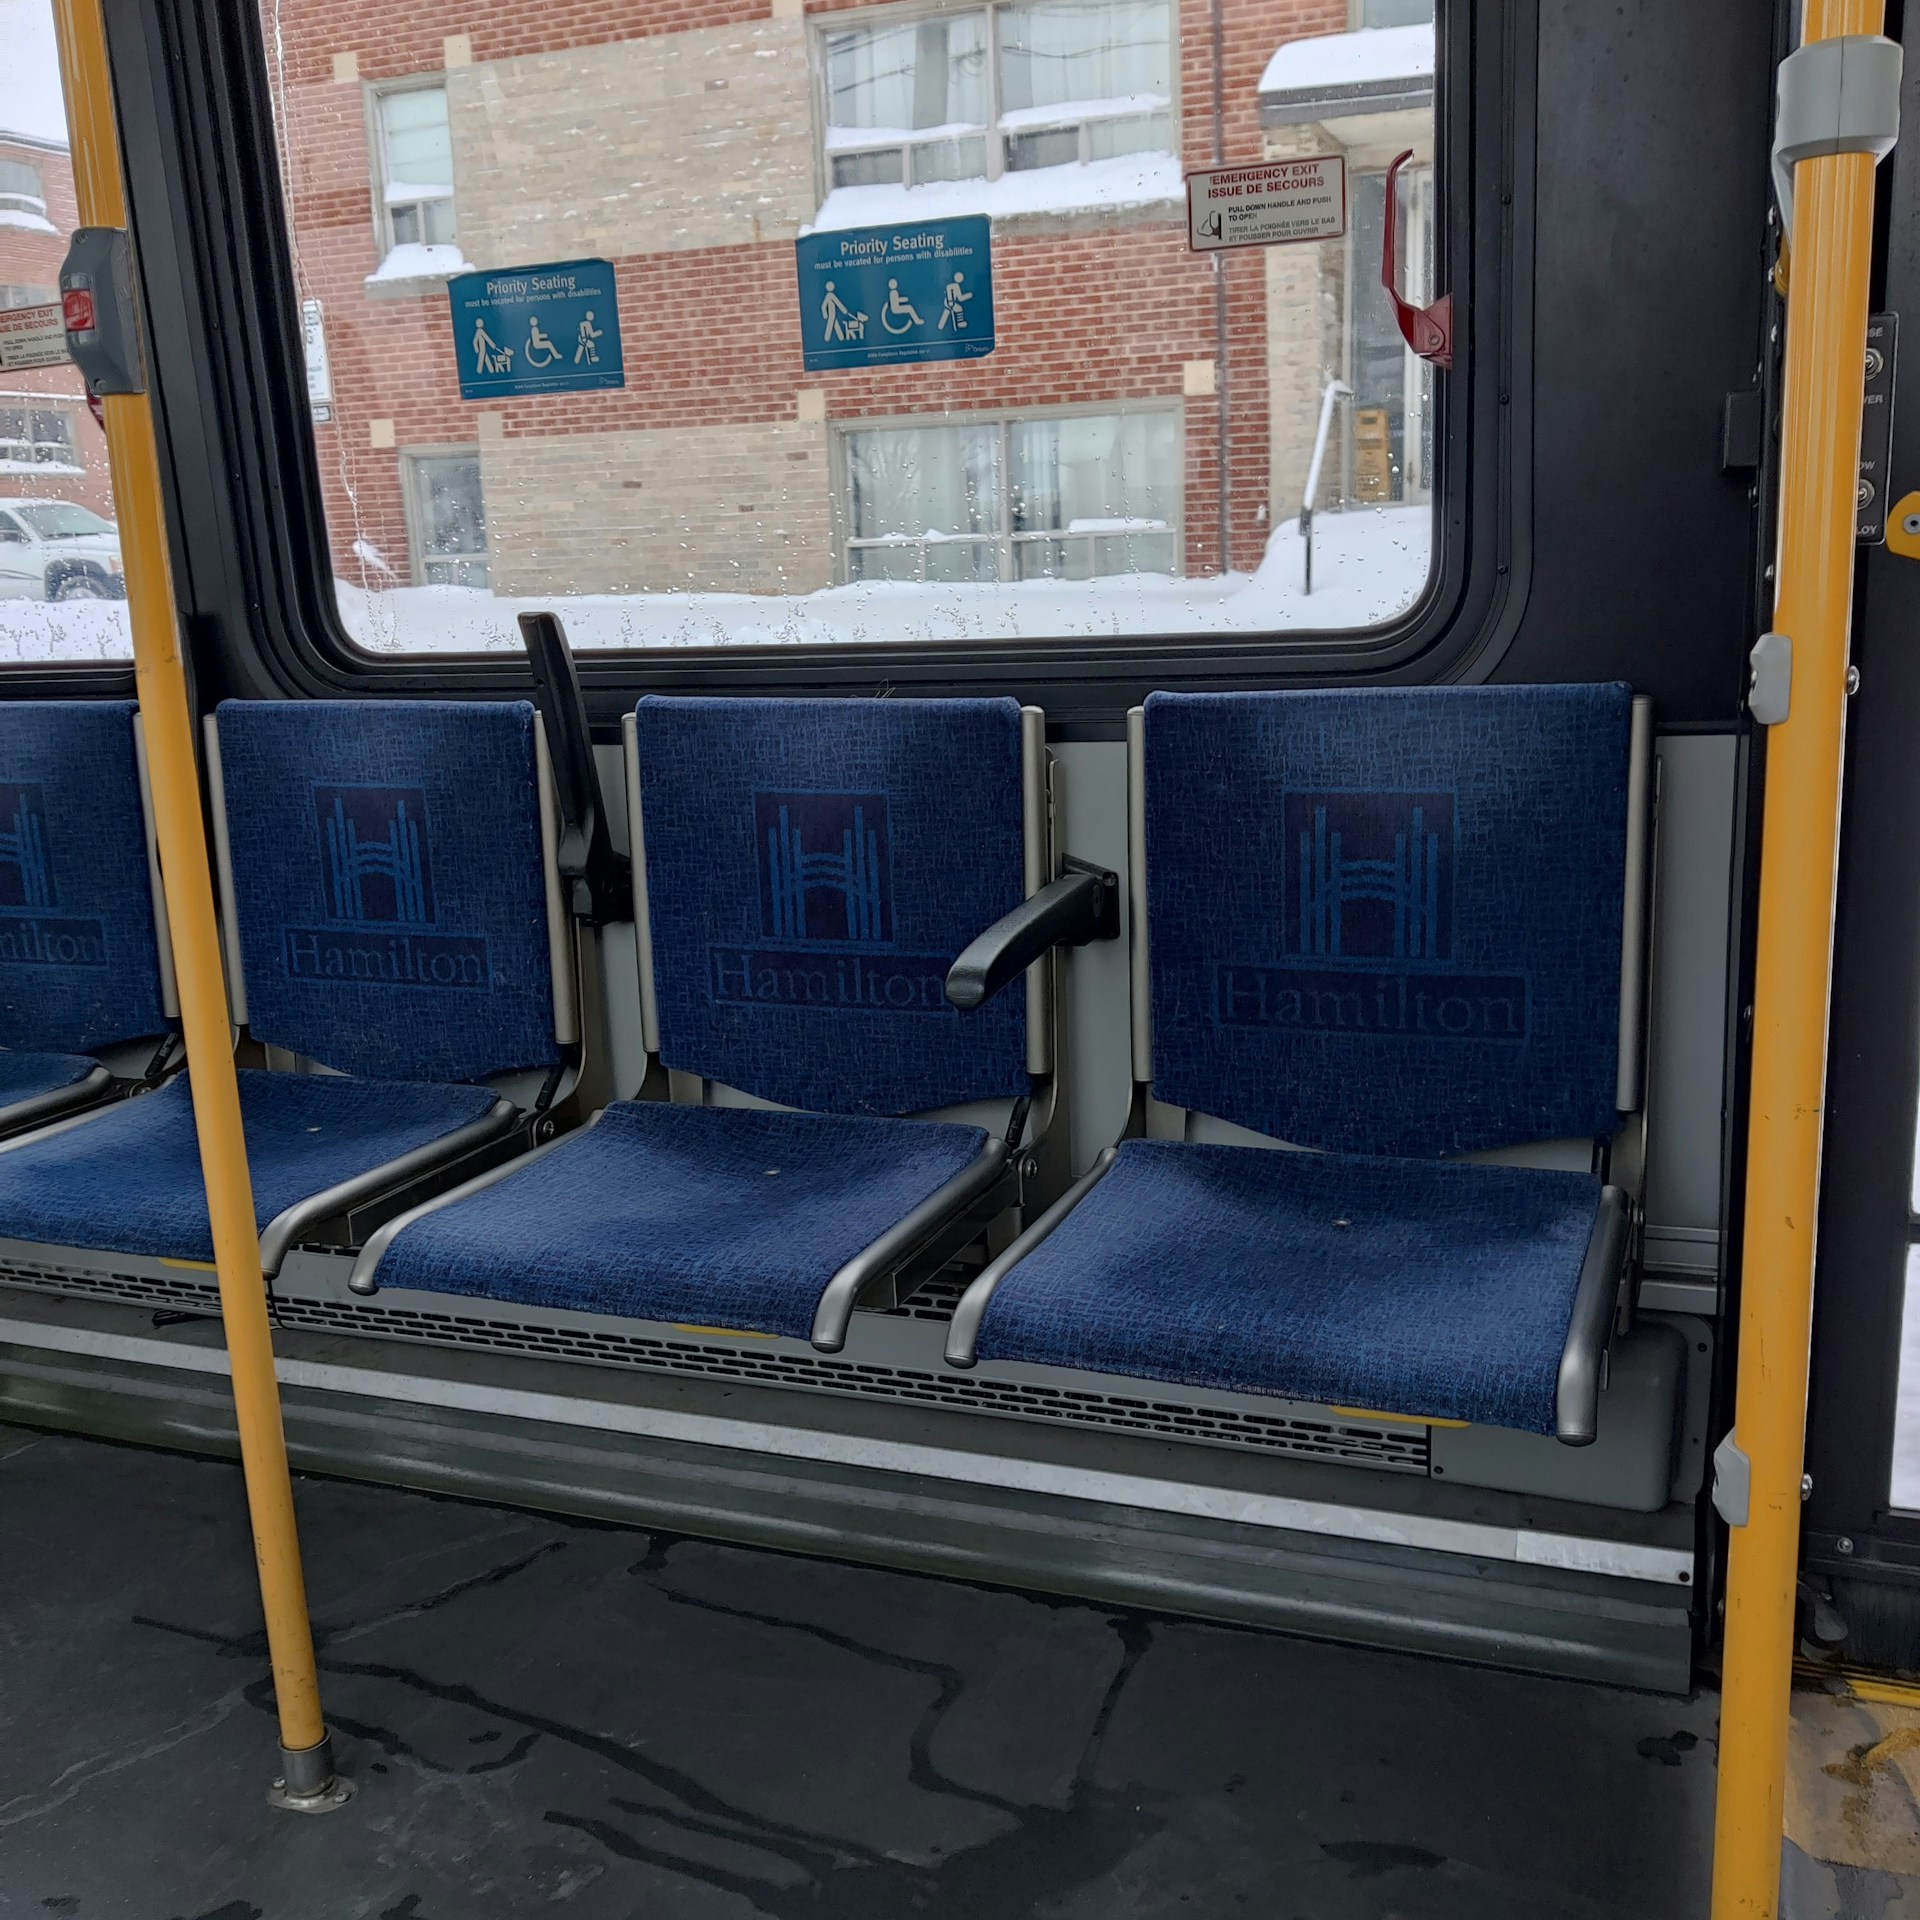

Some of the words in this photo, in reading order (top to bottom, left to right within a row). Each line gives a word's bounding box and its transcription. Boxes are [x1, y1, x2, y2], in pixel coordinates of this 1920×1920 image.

[1210, 167, 1288, 185] EMERGENCY
[1292, 164, 1320, 176] EXIT
[1208, 186, 1242, 198] ISSUE
[1246, 183, 1263, 194] DE
[1266, 176, 1325, 192] SECOURS
[1228, 205, 1245, 213] PULL
[1246, 203, 1266, 211] DOWN
[1267, 200, 1295, 209] HANDLE
[1297, 198, 1311, 206] AND
[1312, 196, 1332, 204] PUSH
[1229, 226, 1248, 234] TIRER
[1292, 219, 1309, 228] VERS
[1239, 213, 1257, 221] OPEN
[840, 239, 888, 256] Priority
[893, 233, 945, 251] Seating
[1272, 230, 1291, 239] POUR
[814, 261, 832, 270] must
[833, 259, 843, 268] be
[844, 257, 872, 267] vacated
[873, 255, 884, 264] for
[885, 254, 914, 265] persons
[916, 251, 932, 260] with
[933, 247, 974, 259] disabilities
[486, 280, 528, 296] Priority
[532, 275, 576, 291] Seating
[464, 300, 480, 308] must
[481, 299, 490, 307] be
[526, 293, 551, 304] persons
[552, 290, 566, 299] with
[567, 288, 601, 299] disabilities
[0, 312, 36, 323] ERGENCY
[290, 932, 485, 984] Hamilton
[714, 952, 946, 1006] Hamilton
[1224, 971, 1520, 1033] Hamilton
